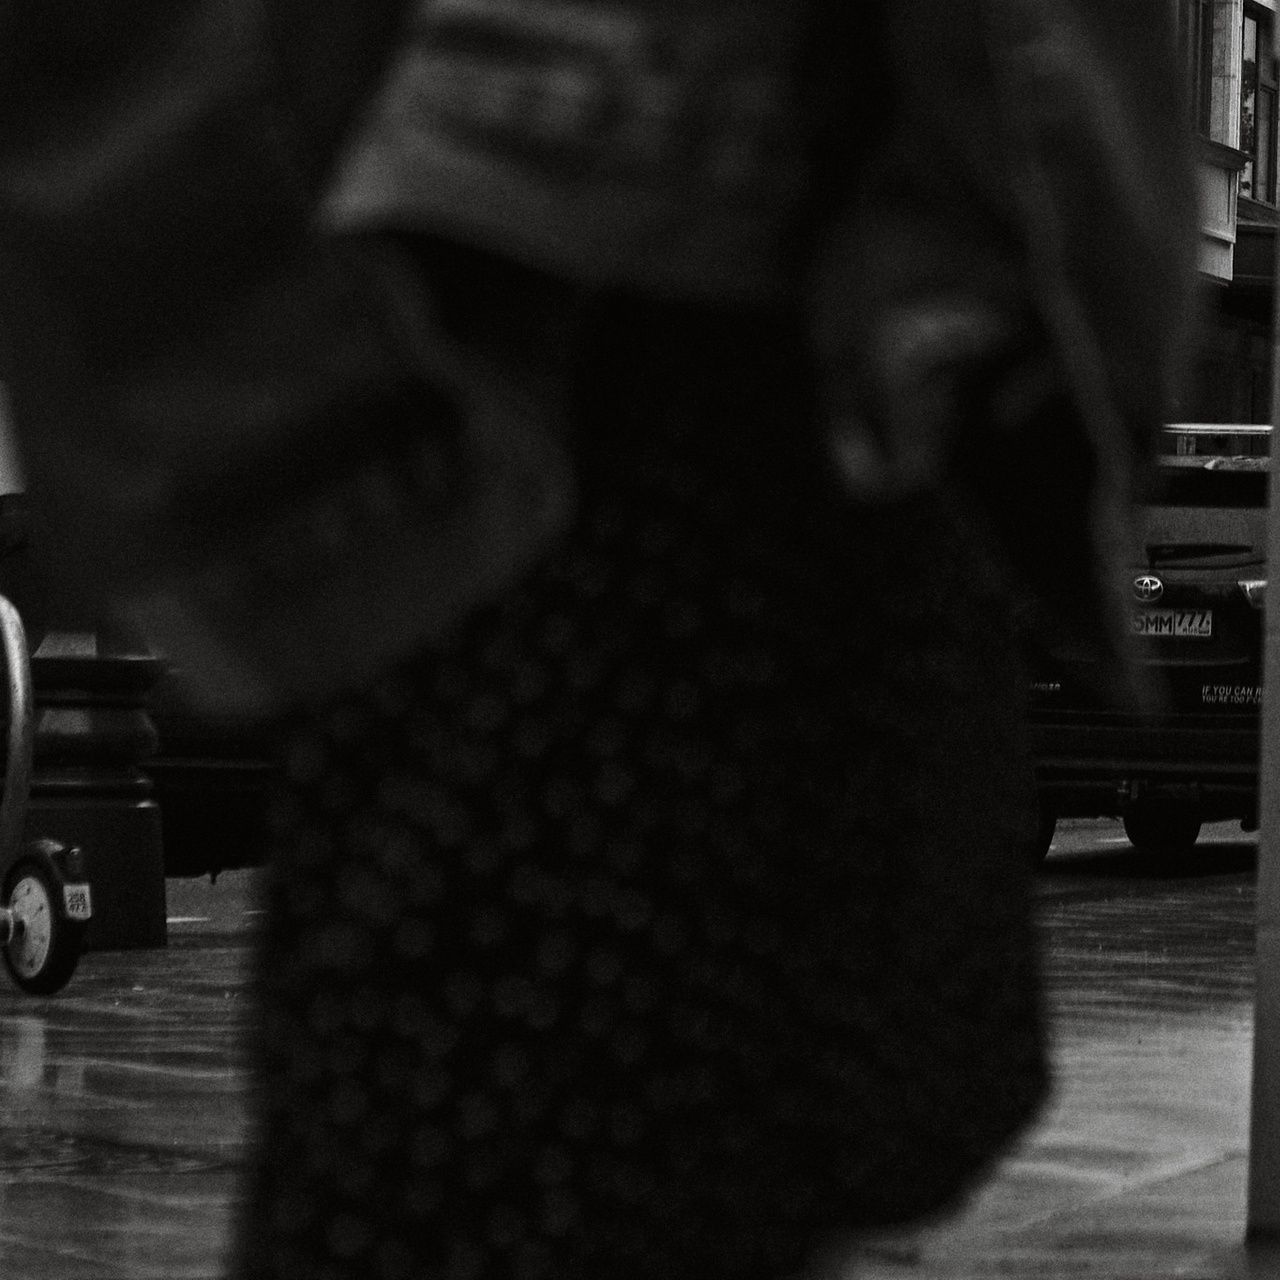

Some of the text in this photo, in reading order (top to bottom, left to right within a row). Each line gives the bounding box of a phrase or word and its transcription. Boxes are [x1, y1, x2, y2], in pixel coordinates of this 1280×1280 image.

[1202, 686, 1210, 695] IF
[1213, 686, 1231, 695] YOU
[1234, 686, 1253, 696] CAN
